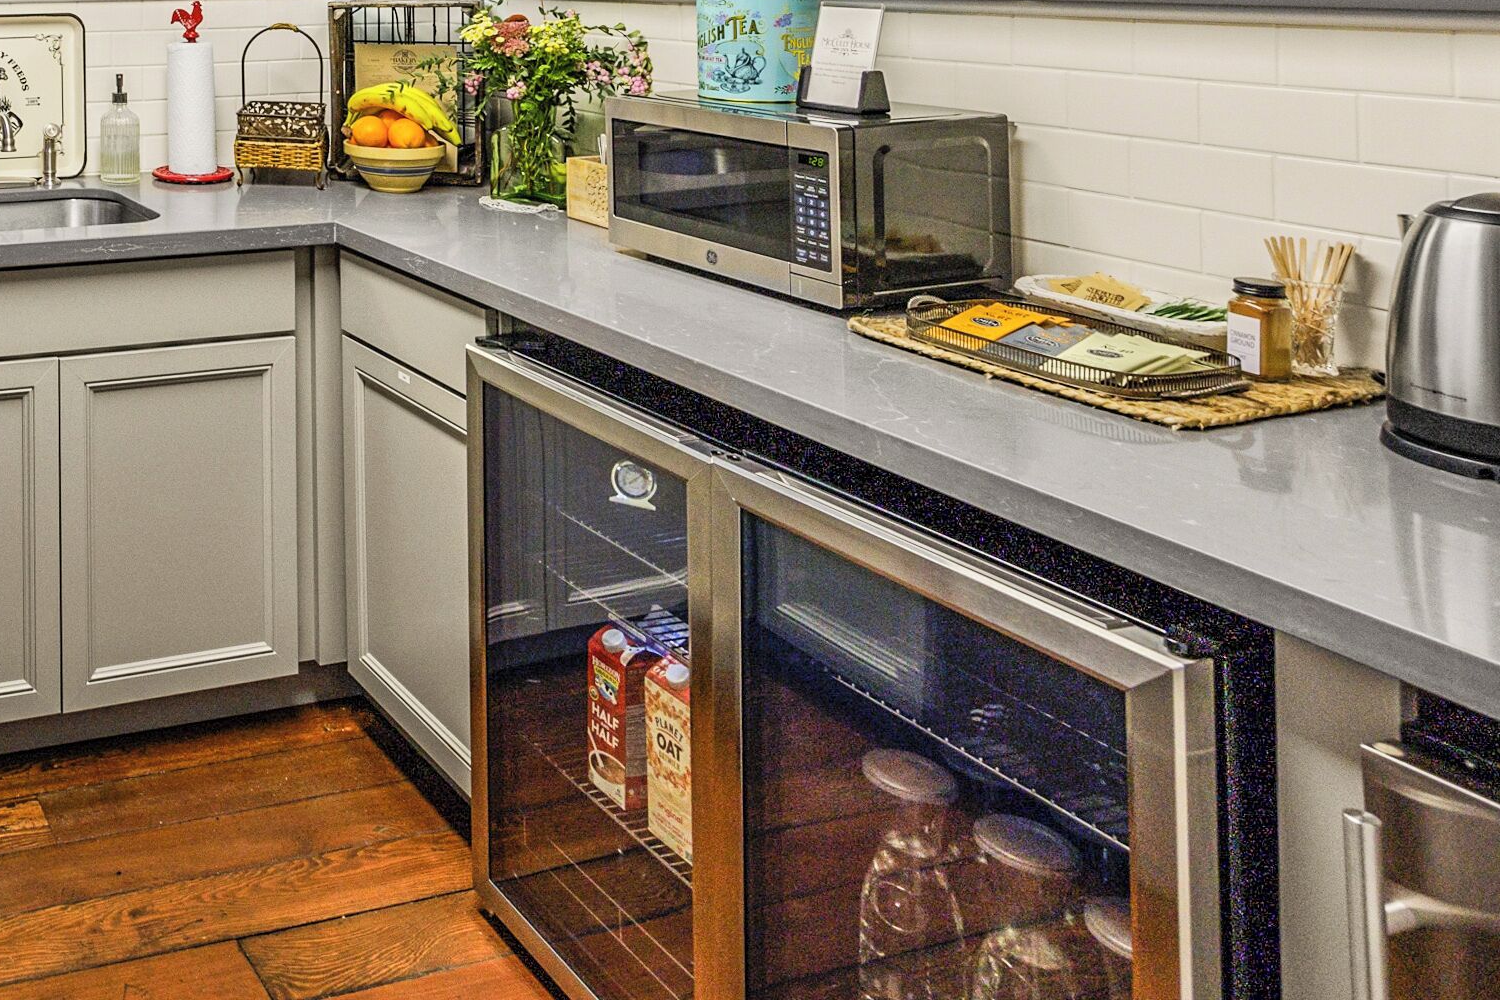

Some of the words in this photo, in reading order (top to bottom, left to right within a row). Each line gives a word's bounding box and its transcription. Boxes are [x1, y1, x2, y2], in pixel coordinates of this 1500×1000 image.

[7, 58, 30, 92] FEEDS
[1230, 336, 1256, 349] GROUND
[592, 701, 619, 731] HALF
[655, 716, 683, 742] PLANET
[591, 719, 619, 749] HALF
[657, 732, 683, 762] OAT
